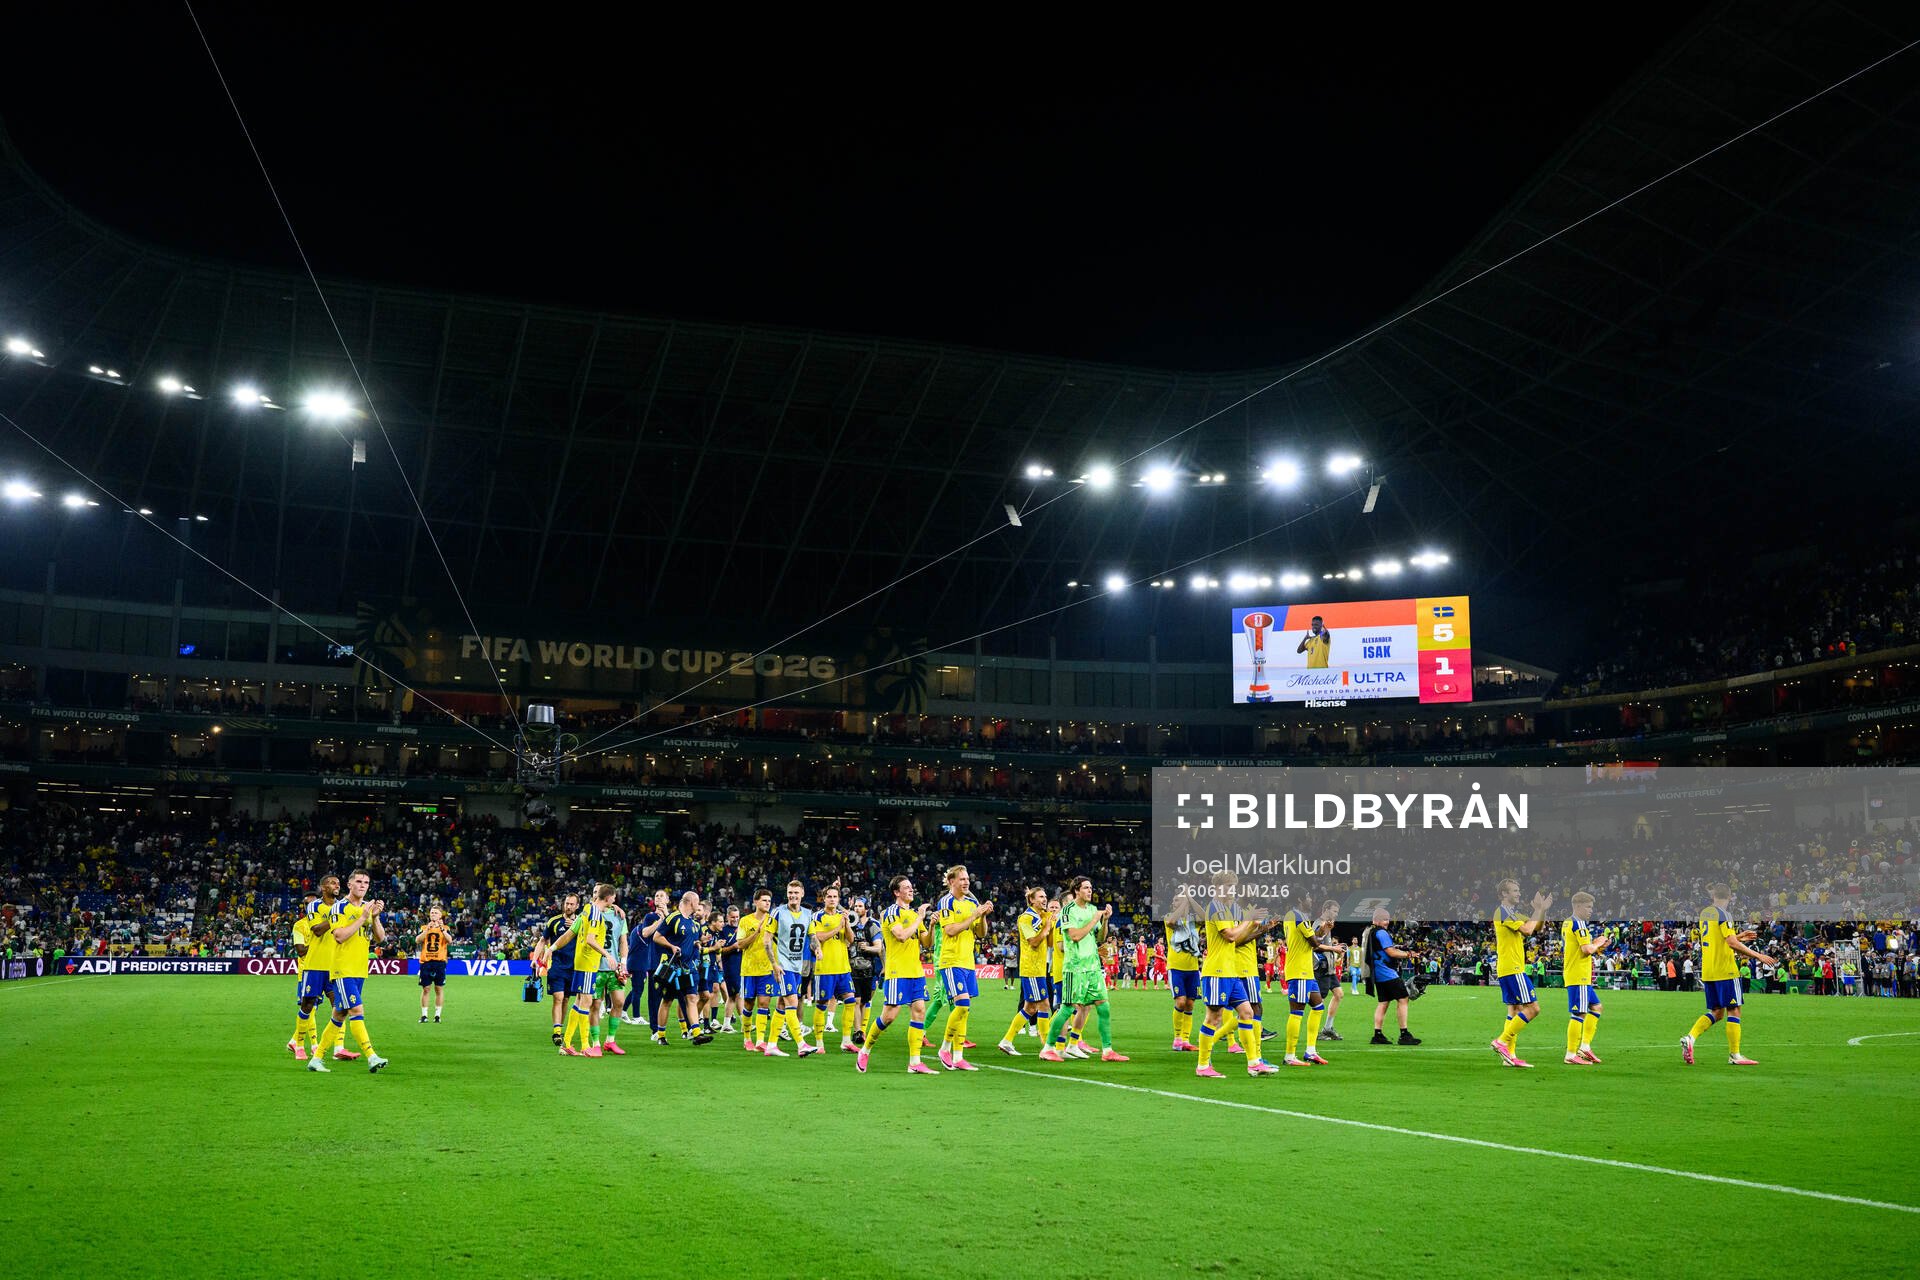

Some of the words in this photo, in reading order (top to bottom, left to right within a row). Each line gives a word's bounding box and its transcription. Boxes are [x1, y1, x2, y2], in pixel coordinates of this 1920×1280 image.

[1433, 623, 1454, 642] 5
[461, 634, 532, 662] FIFA
[538, 639, 655, 670] WORLD
[660, 648, 724, 674] CUP
[729, 652, 837, 680] 2026
[1363, 645, 1391, 658] ISAK
[1435, 657, 1455, 675] 1
[1286, 673, 1338, 688] Michelob
[1354, 671, 1406, 684] ULTRA
[1305, 699, 1347, 708] Hisense
[31, 707, 52, 717] FIFA
[53, 709, 87, 719] WORLD
[88, 711, 107, 720] CUP
[663, 739, 740, 749] MONTERREY
[1423, 752, 1497, 763] MONTERREY
[322, 777, 408, 789] MONTERREY
[601, 788, 619, 796] FIFA
[620, 789, 648, 797] WORLD
[666, 790, 694, 799] 2026
[878, 798, 950, 808] MONTERREY
[78, 960, 116, 973] ADI
[121, 960, 233, 972] PREDICTSTREET
[246, 959, 299, 974] QATA
[462, 960, 511, 976] VISA
